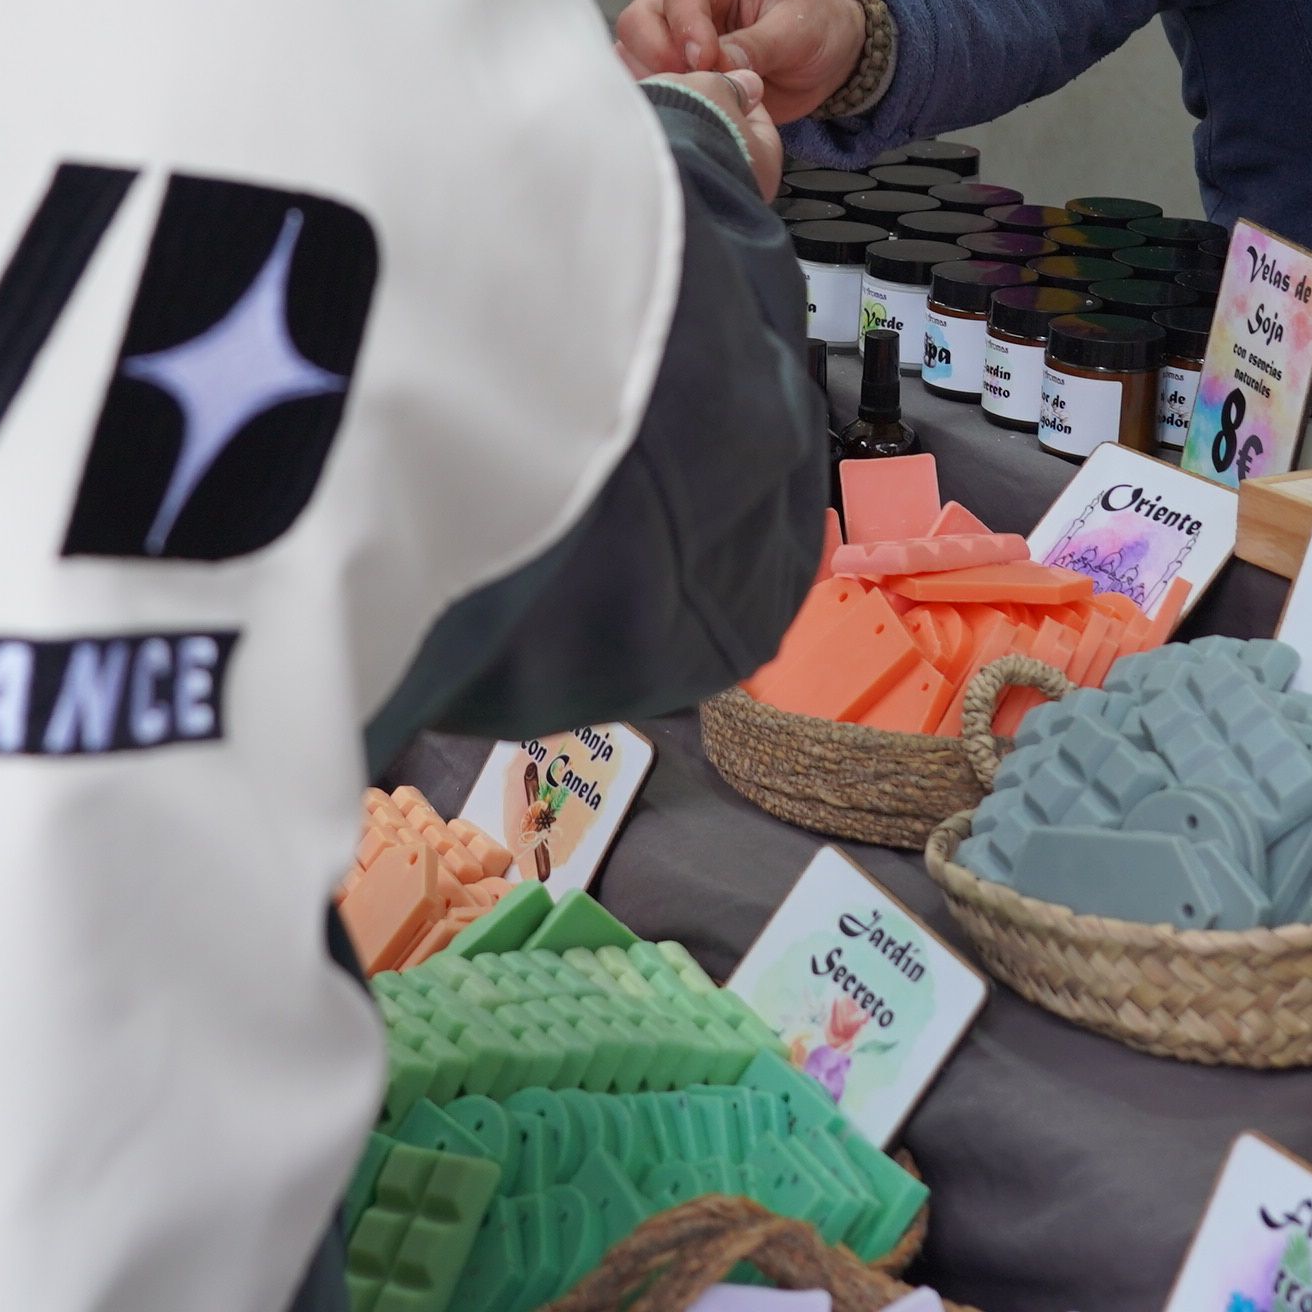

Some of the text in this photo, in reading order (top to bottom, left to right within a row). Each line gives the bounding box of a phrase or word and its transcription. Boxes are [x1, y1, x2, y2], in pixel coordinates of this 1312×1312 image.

[1247, 244, 1312, 305] Velas de
[864, 307, 905, 331] Verde
[1247, 302, 1285, 346] Soja
[1233, 343, 1284, 382] con esencias
[1052, 393, 1067, 409] de
[1169, 390, 1187, 405] de
[1233, 368, 1272, 399] naturales
[1101, 484, 1203, 536] Oriente
[569, 726, 614, 762] anja
[546, 754, 602, 811] Canela
[838, 908, 926, 983] Jardín
[810, 946, 896, 1029] Secreto
